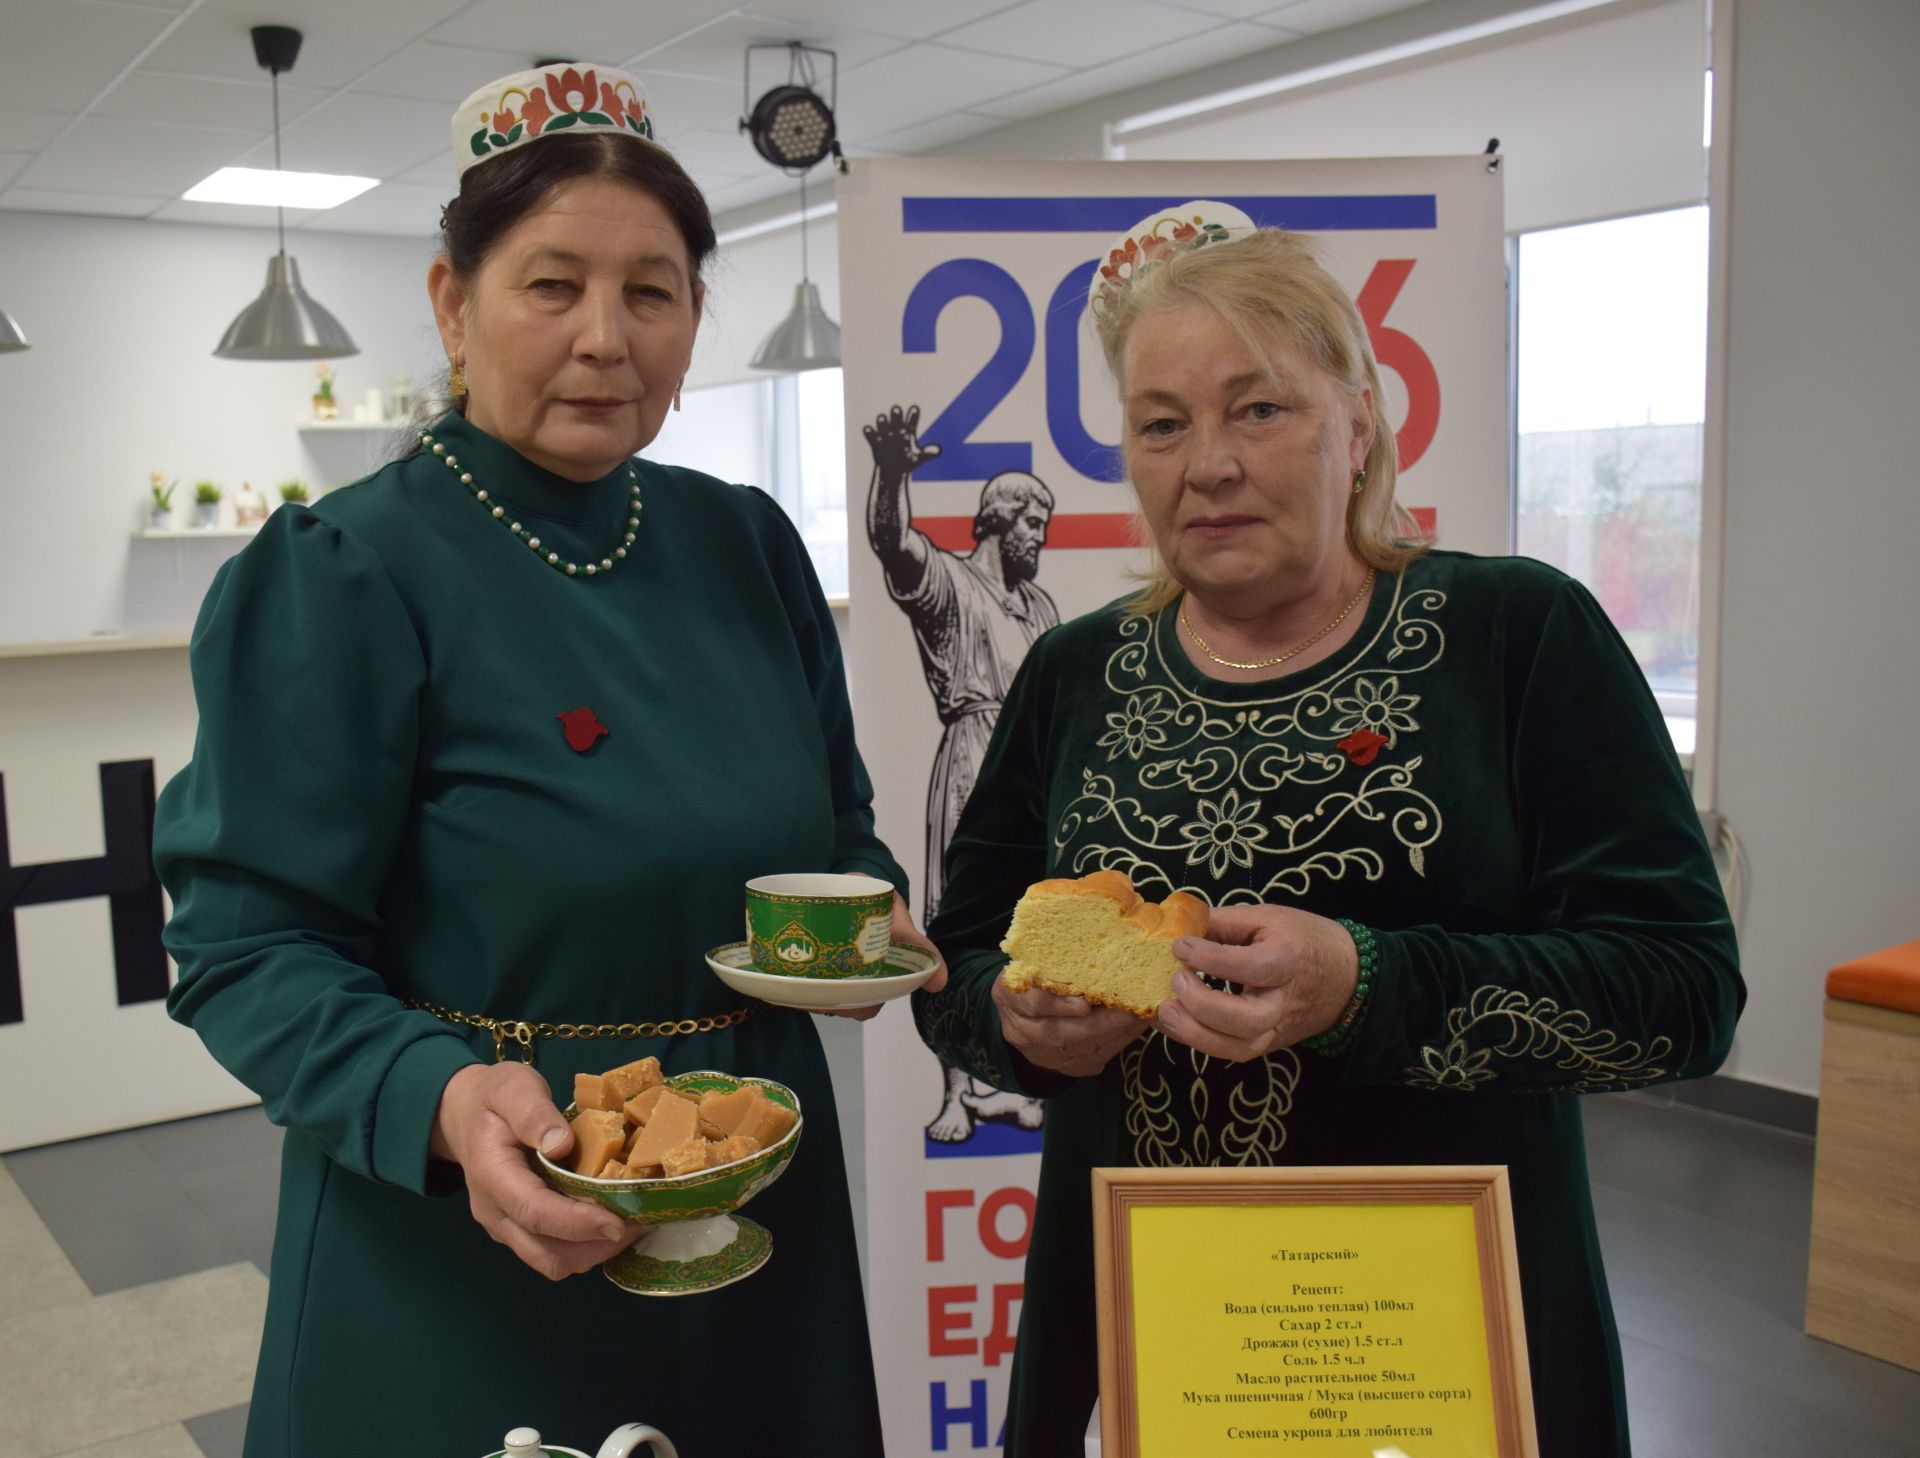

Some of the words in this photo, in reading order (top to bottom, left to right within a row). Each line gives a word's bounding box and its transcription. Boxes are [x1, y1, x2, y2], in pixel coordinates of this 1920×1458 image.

[902, 258, 1440, 483] 206
[1272, 1249, 1359, 1263] «Татарский»
[1292, 1284, 1343, 1296] Рецепт:
[1224, 1303, 1257, 1315] Вода
[1261, 1303, 1314, 1315] (сильно
[1318, 1300, 1369, 1314] теплая)
[1374, 1300, 1414, 1312] 100мл
[1279, 1319, 1321, 1333] Сахар
[1325, 1318, 1332, 1330] 2
[1336, 1320, 1362, 1330] ст.л
[1242, 1338, 1299, 1351] Дрожжи
[1303, 1336, 1350, 1350] (сухие)
[1355, 1336, 1373, 1347] 1.5
[1377, 1337, 1403, 1347] ст.л
[1283, 1354, 1318, 1366] Соль
[1323, 1353, 1341, 1365] 1.5
[1344, 1355, 1365, 1365] ч.л
[1236, 1373, 1281, 1385] Масло
[1285, 1373, 1377, 1387] растительное
[1381, 1370, 1415, 1382] 50мл
[1182, 1391, 1221, 1406] Мука
[1225, 1392, 1304, 1403] пшеничная
[1316, 1389, 1354, 1404] Мука
[1358, 1387, 1425, 1402] (высшего
[1428, 1387, 1472, 1402] сорта)
[1309, 1407, 1348, 1422] 600гр
[1227, 1427, 1279, 1439] Семена
[1283, 1428, 1332, 1441] укропа
[1336, 1428, 1361, 1438] для
[1364, 1425, 1433, 1438] любителя
